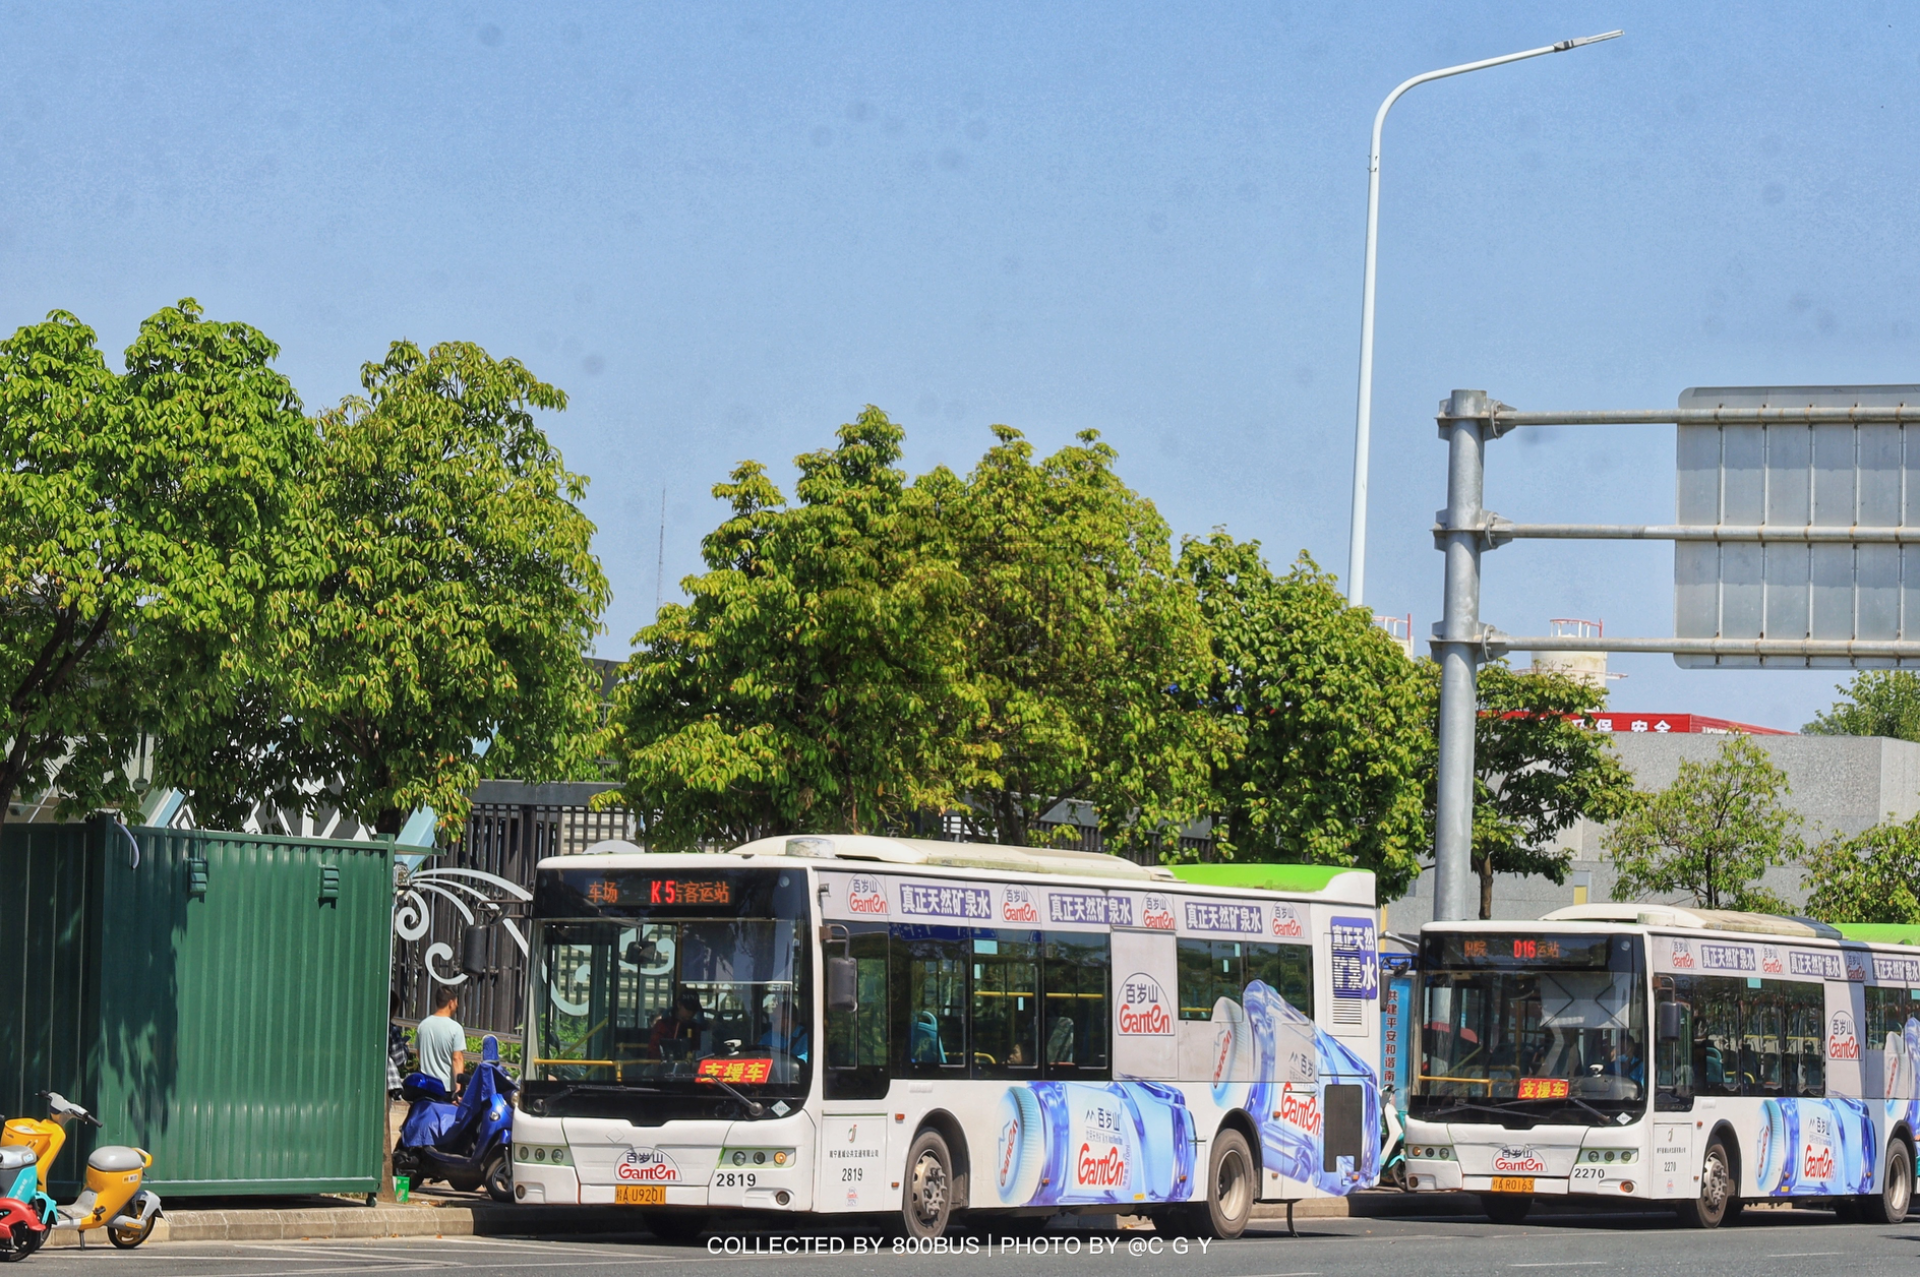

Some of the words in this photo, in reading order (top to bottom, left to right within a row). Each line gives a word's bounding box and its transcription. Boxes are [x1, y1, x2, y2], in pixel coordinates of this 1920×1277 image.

[1631, 720, 1671, 733] 安全
[588, 881, 618, 903] 车场
[651, 880, 676, 904] K5
[853, 879, 878, 894] 百岁山
[901, 884, 990, 918] 真正天然矿泉水
[1006, 889, 1028, 903] 百岁山
[1146, 897, 1167, 910] 百岁山
[1050, 895, 1131, 924] 真正天然矿泉水
[1186, 904, 1261, 932] 真正天然矿泉水
[1274, 906, 1294, 919] 百岁山
[1331, 924, 1375, 951] 真正天然
[1513, 940, 1536, 958] D16
[1702, 946, 1755, 970] 真正天然矿泉水
[1790, 953, 1840, 976] 真正天然矿泉水
[1873, 960, 1919, 981] 真正天然矿泉水
[1126, 983, 1158, 1004] 百岁山
[1119, 1003, 1170, 1034] Ganten
[1833, 1019, 1853, 1035] 百岁山
[701, 1062, 766, 1082] 支援车
[1521, 1081, 1566, 1098] 支援车
[1097, 1107, 1120, 1131] 百岁山
[626, 1152, 663, 1163] 百岁山
[1495, 1157, 1543, 1171] Ganten
[618, 1163, 676, 1180] Ganten
[841, 1167, 863, 1182] 2819
[1574, 1168, 1605, 1179] 2270
[1664, 1161, 1677, 1172] 2270
[716, 1173, 757, 1187] 2819
